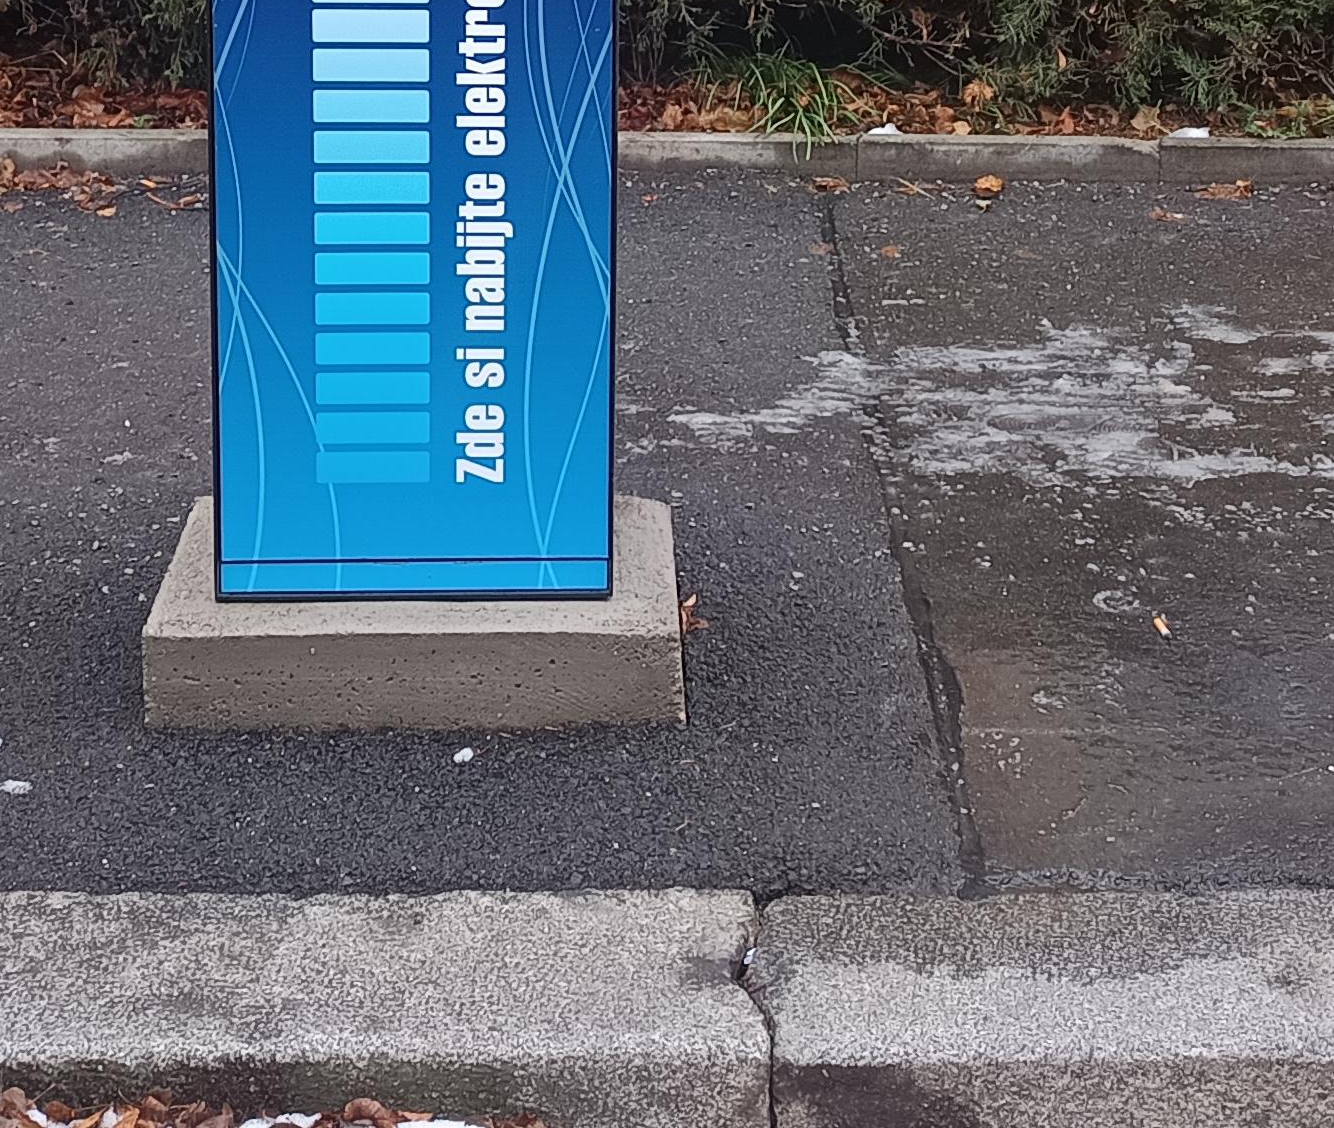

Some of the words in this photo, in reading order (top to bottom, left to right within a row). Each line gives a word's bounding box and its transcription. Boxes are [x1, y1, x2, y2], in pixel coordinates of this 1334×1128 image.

[455, 172, 514, 331] nabijte
[456, 347, 506, 388] si
[456, 404, 506, 483] Zde
